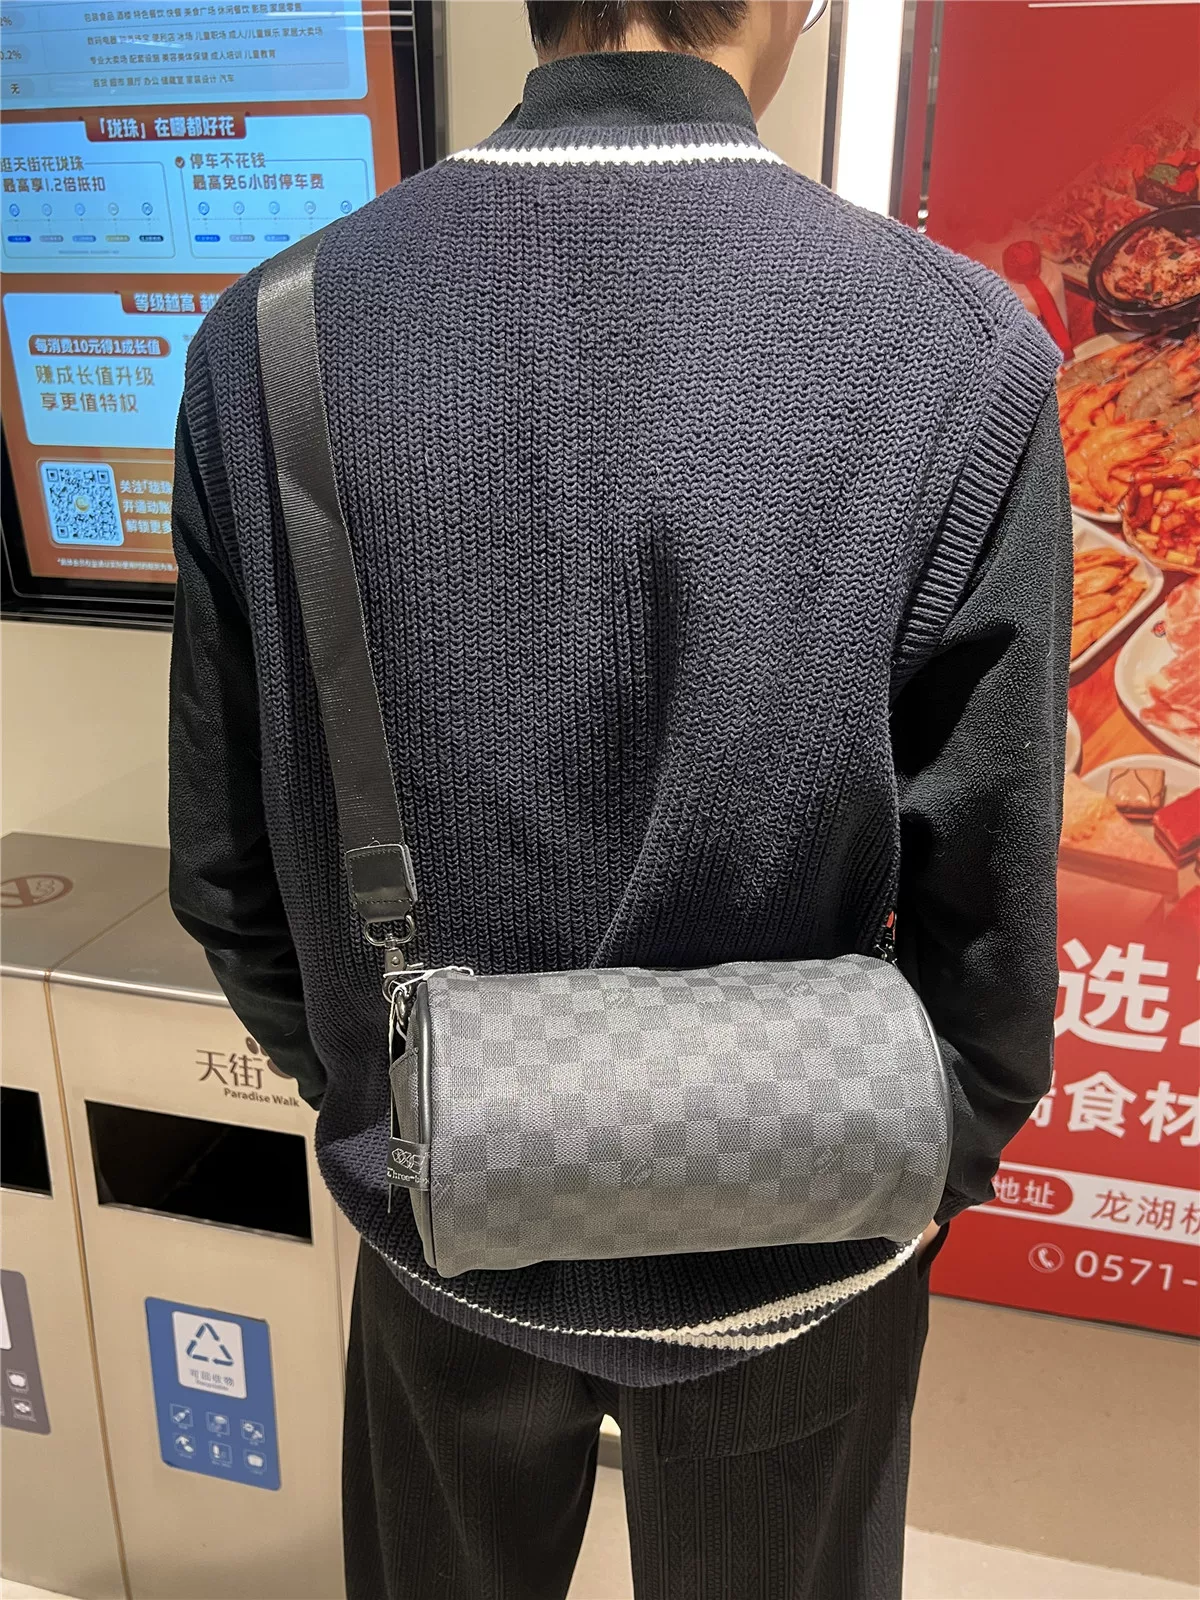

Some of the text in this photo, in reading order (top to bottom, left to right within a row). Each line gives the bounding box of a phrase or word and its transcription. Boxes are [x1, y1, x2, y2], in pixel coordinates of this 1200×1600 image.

[190, 152, 267, 170] 停车不花钱
[192, 173, 325, 191] 最高免6小时停车费
[35, 338, 161, 356] 每消费10元得1成长值
[35, 364, 156, 387] 赚成长值升级
[40, 392, 139, 413] 享更值特权
[195, 1049, 264, 1090] 天街
[223, 1087, 300, 1108] Paradise Walk
